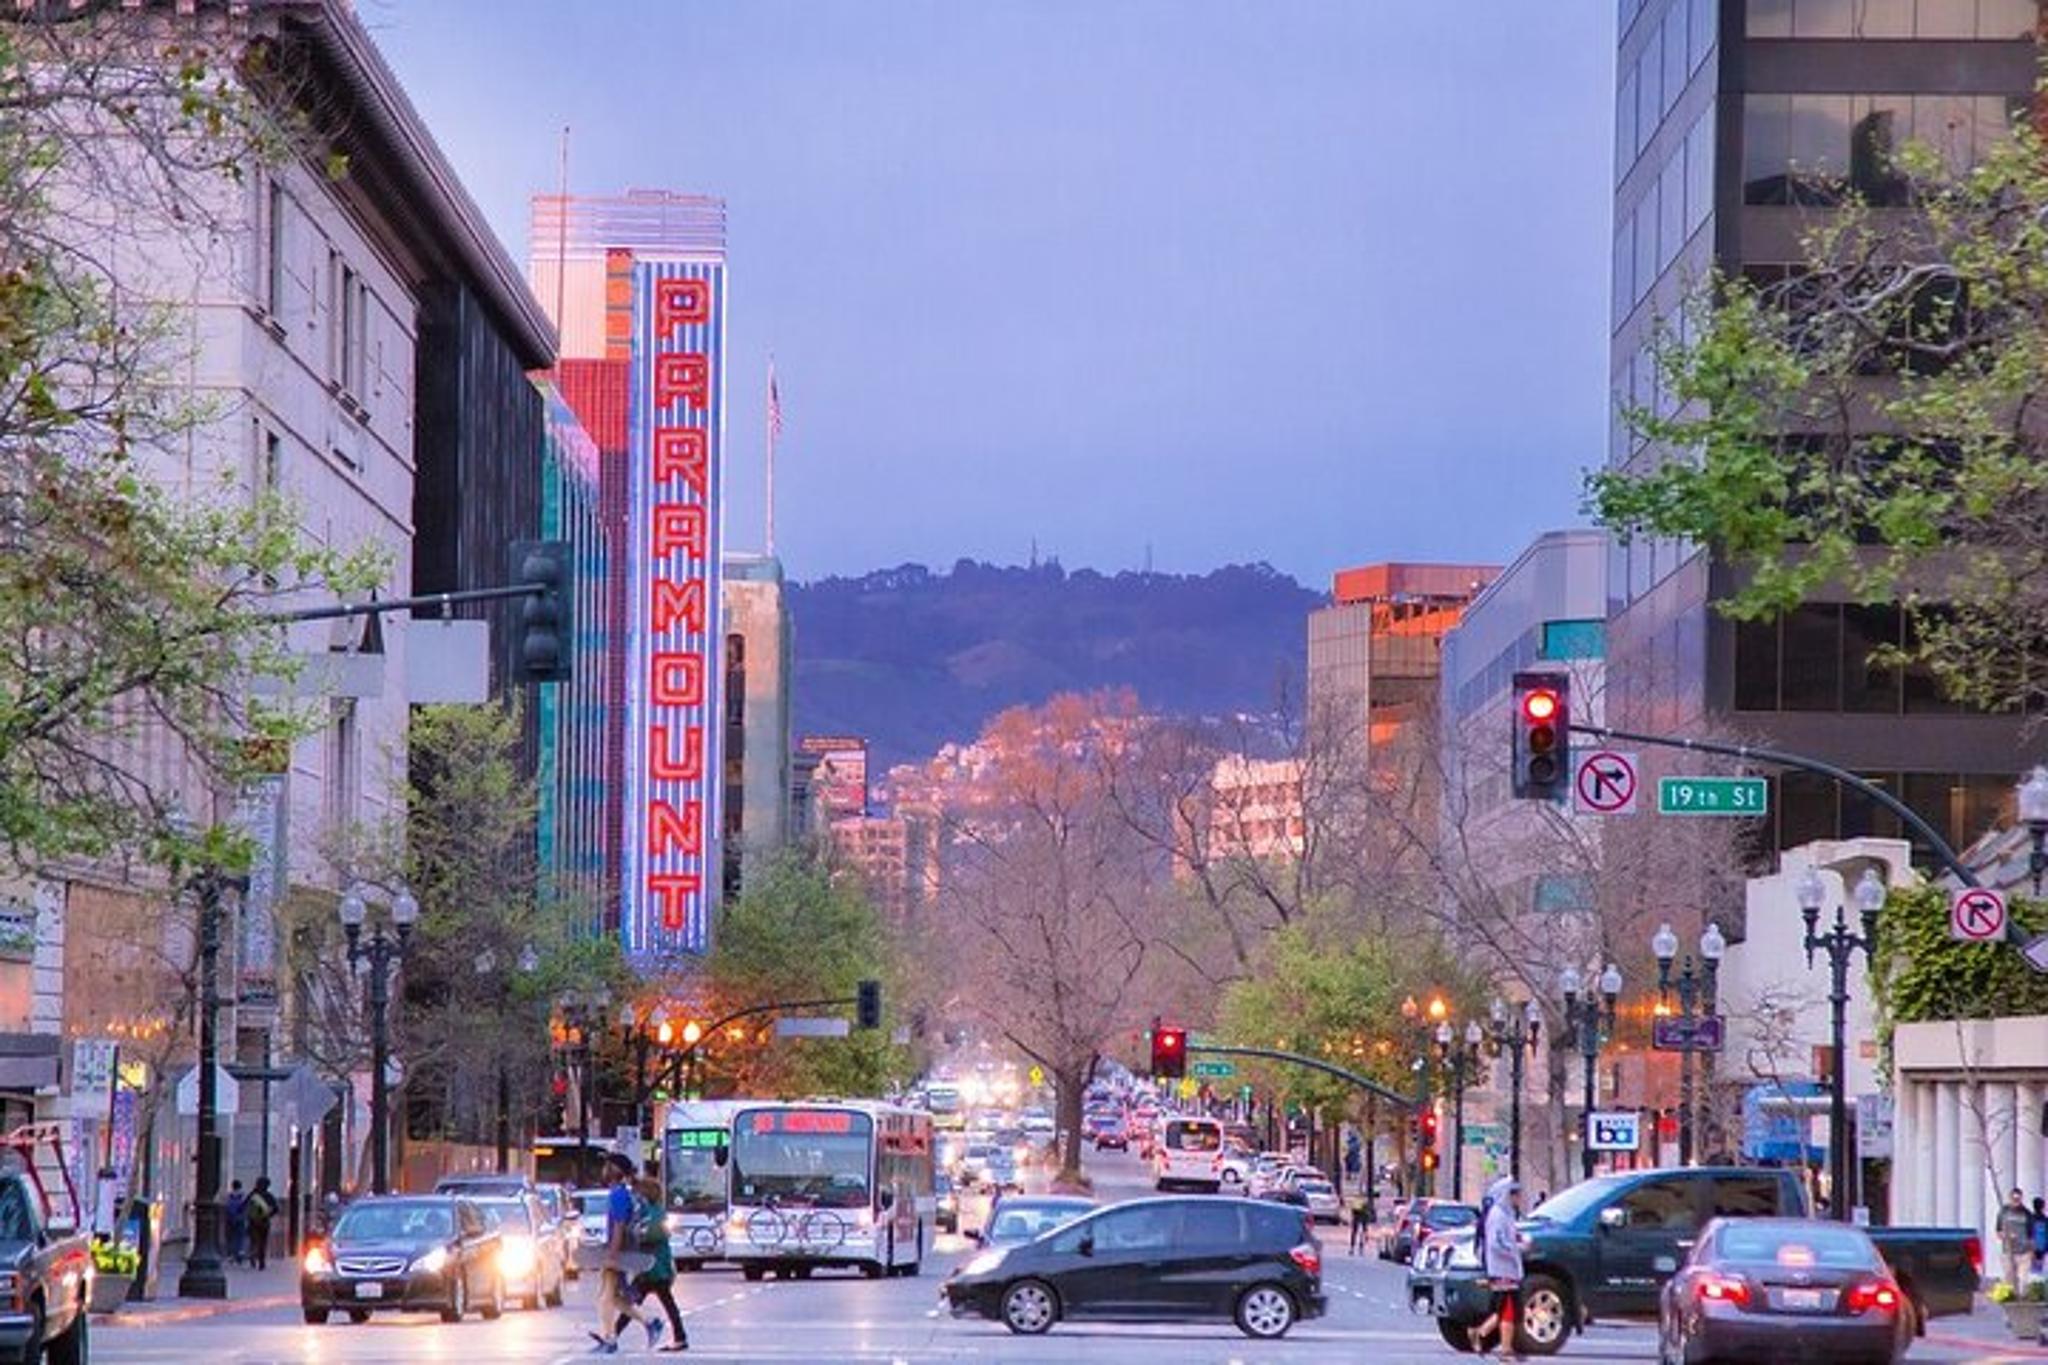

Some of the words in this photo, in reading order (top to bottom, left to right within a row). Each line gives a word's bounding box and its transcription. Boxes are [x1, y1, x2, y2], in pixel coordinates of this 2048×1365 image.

[648, 277, 709, 929] PARAMOUNT
[1671, 784, 1718, 806] 19th
[1732, 786, 1755, 806] St
